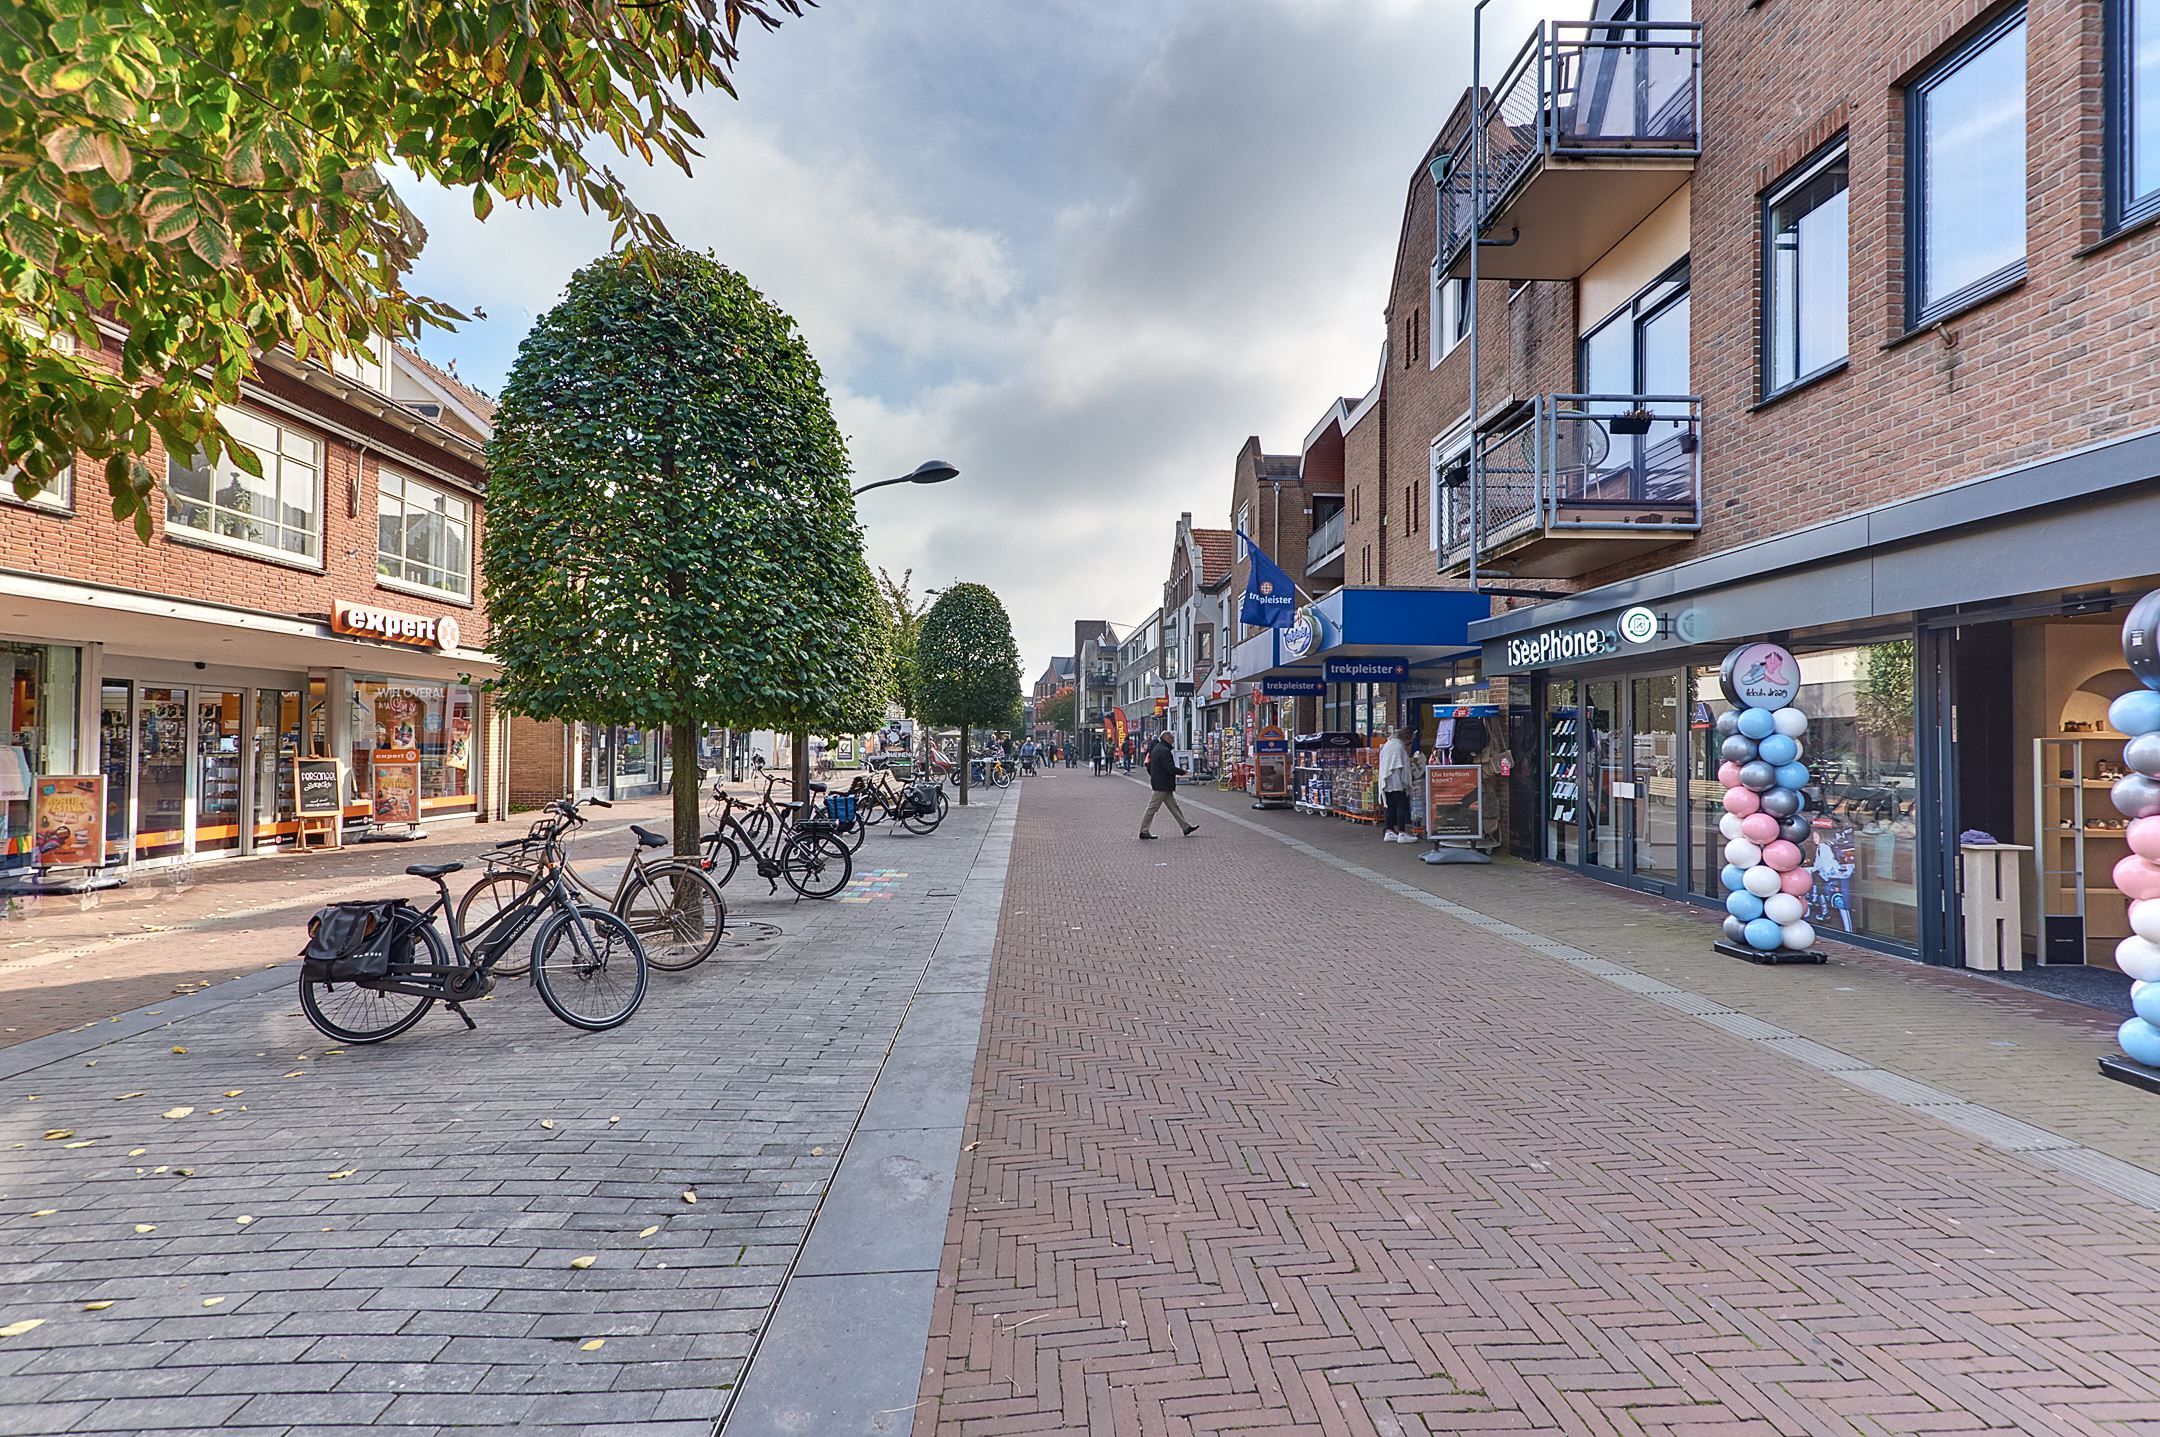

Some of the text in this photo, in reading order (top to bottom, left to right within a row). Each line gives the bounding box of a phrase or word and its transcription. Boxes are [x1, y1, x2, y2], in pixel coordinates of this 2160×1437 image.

[348, 609, 436, 641] expert
[1507, 628, 1600, 668] iSeePhone
[1331, 663, 1393, 675] trekpleister
[403, 687, 445, 698] OVERAL
[1266, 682, 1315, 691] trekpleister
[509, 913, 535, 941] BATAVUS
